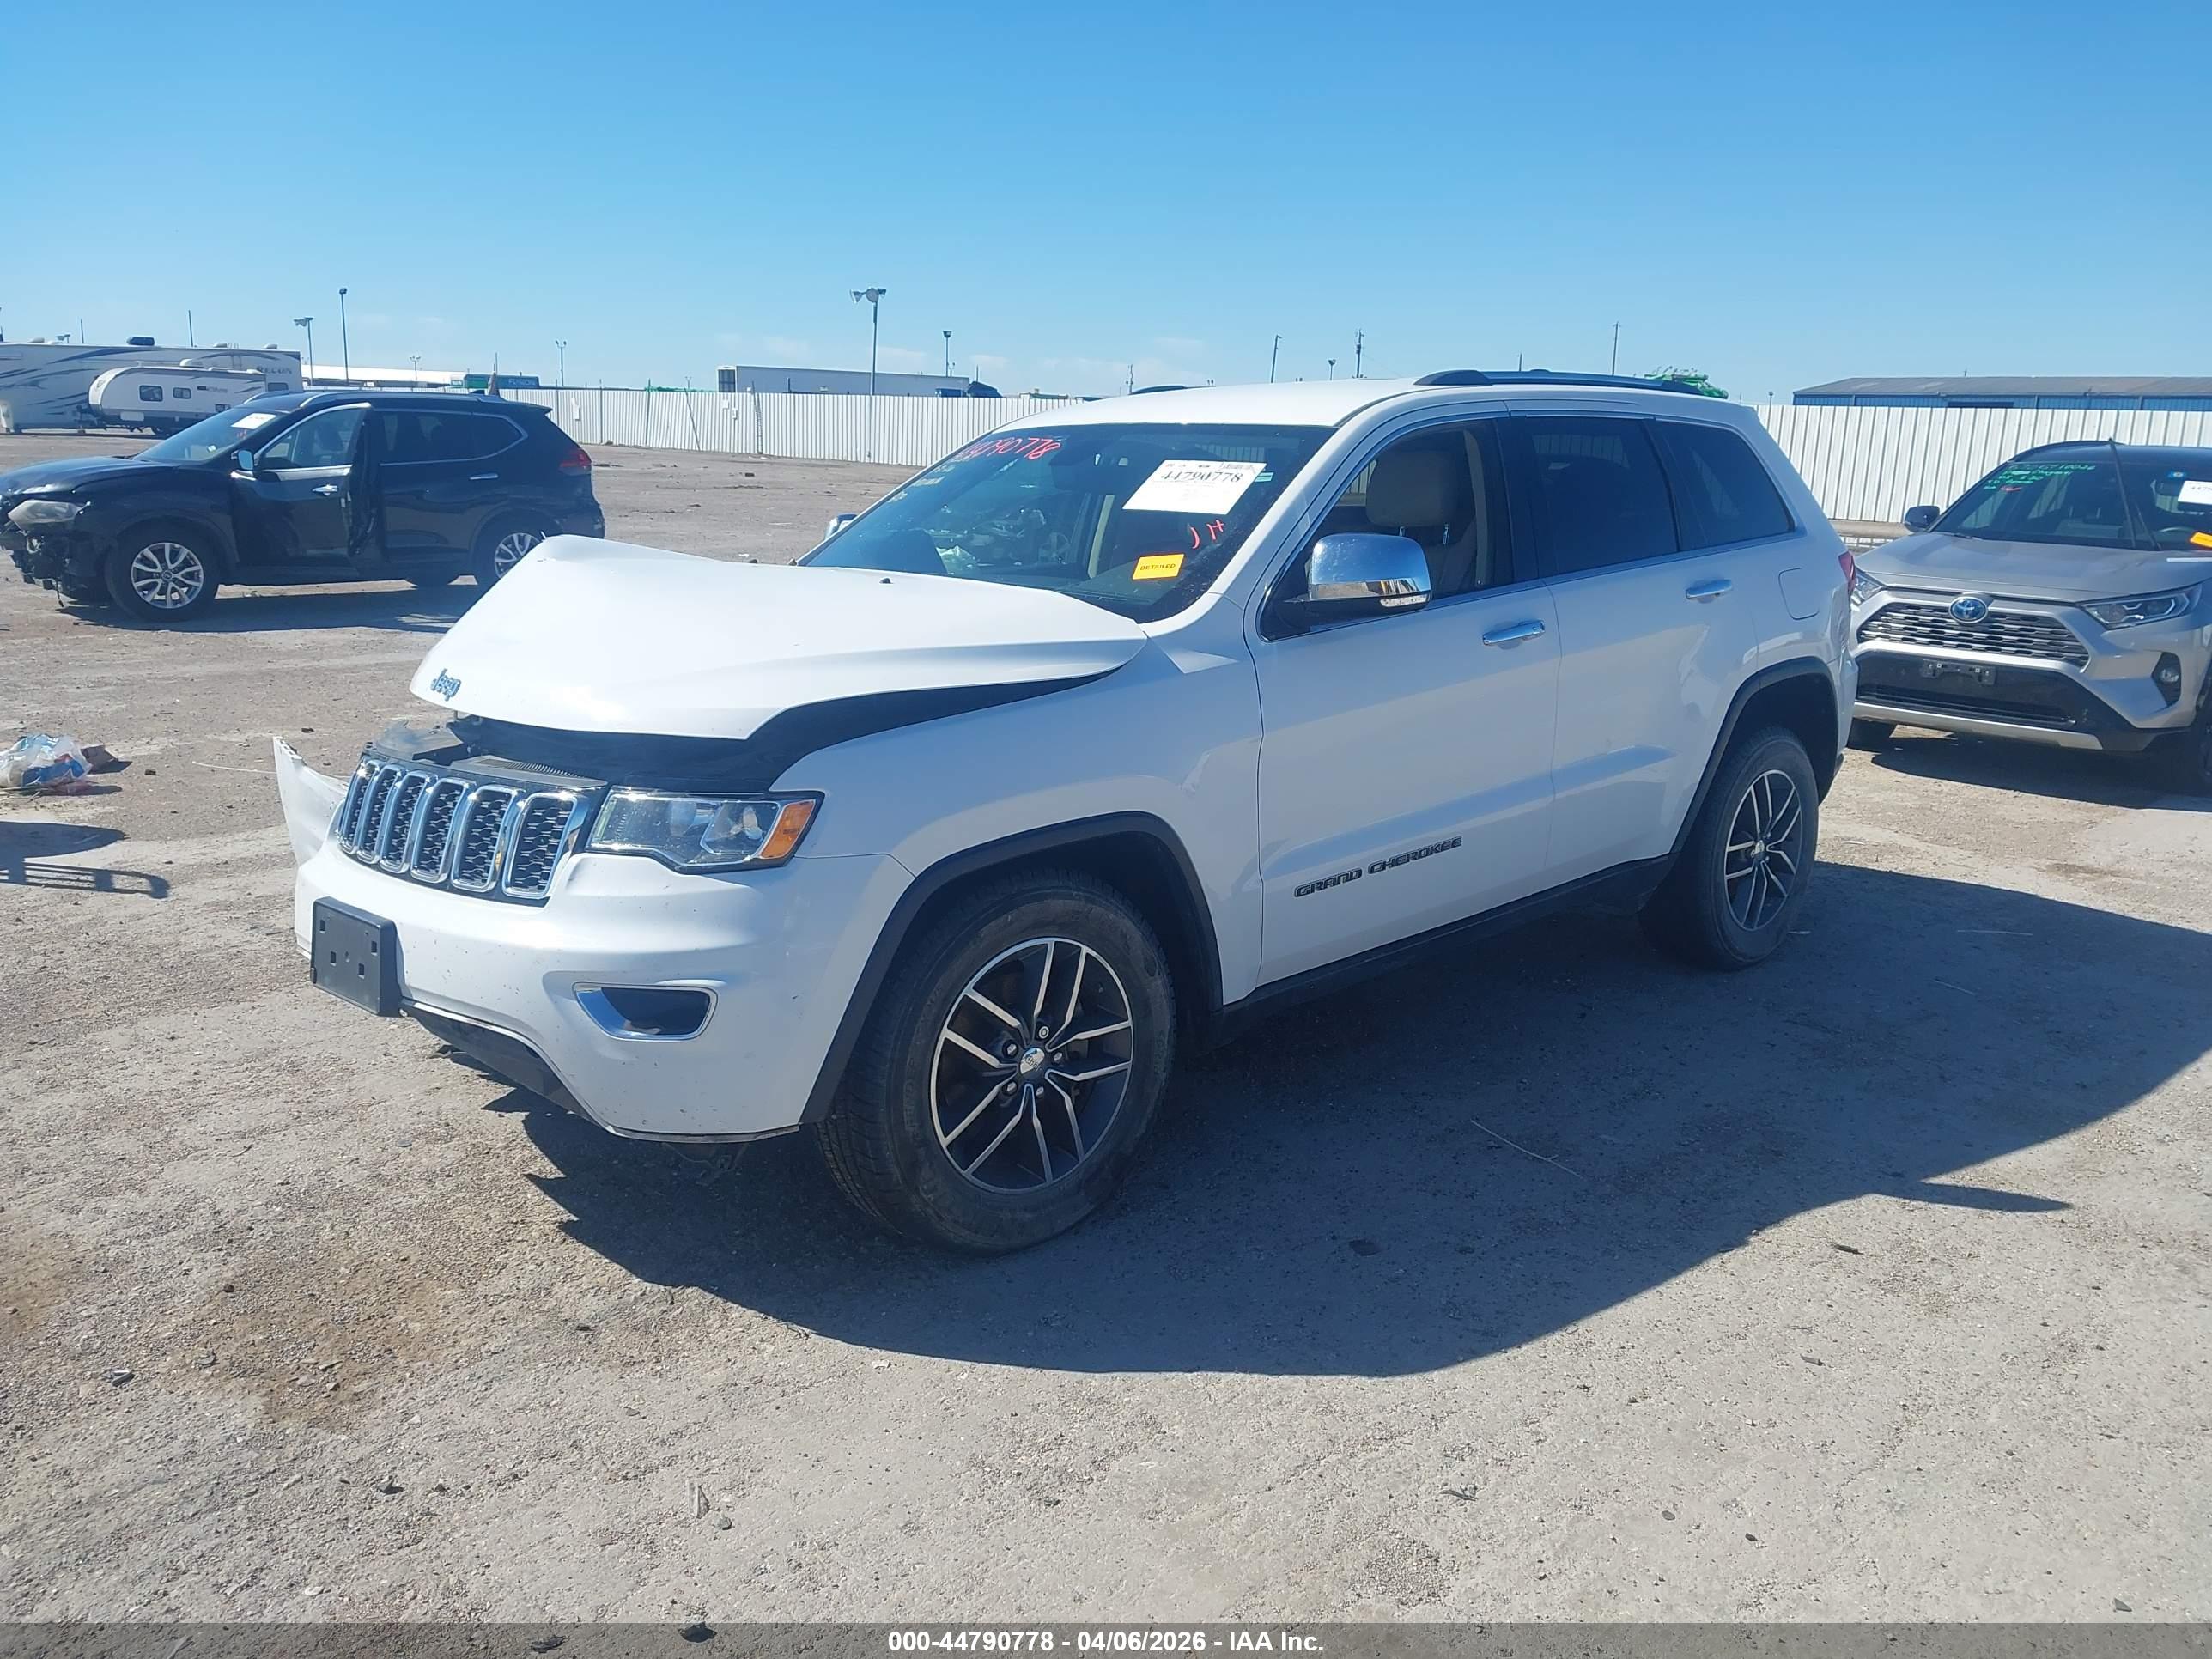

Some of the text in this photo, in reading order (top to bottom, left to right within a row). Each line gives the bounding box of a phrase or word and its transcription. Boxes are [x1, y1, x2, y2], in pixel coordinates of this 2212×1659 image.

[1161, 471, 1244, 483] 44790778
[1139, 562, 1176, 571] DETAILED
[430, 668, 461, 702] Jeep
[1294, 836, 1462, 898] GRAND CHEROKEE
